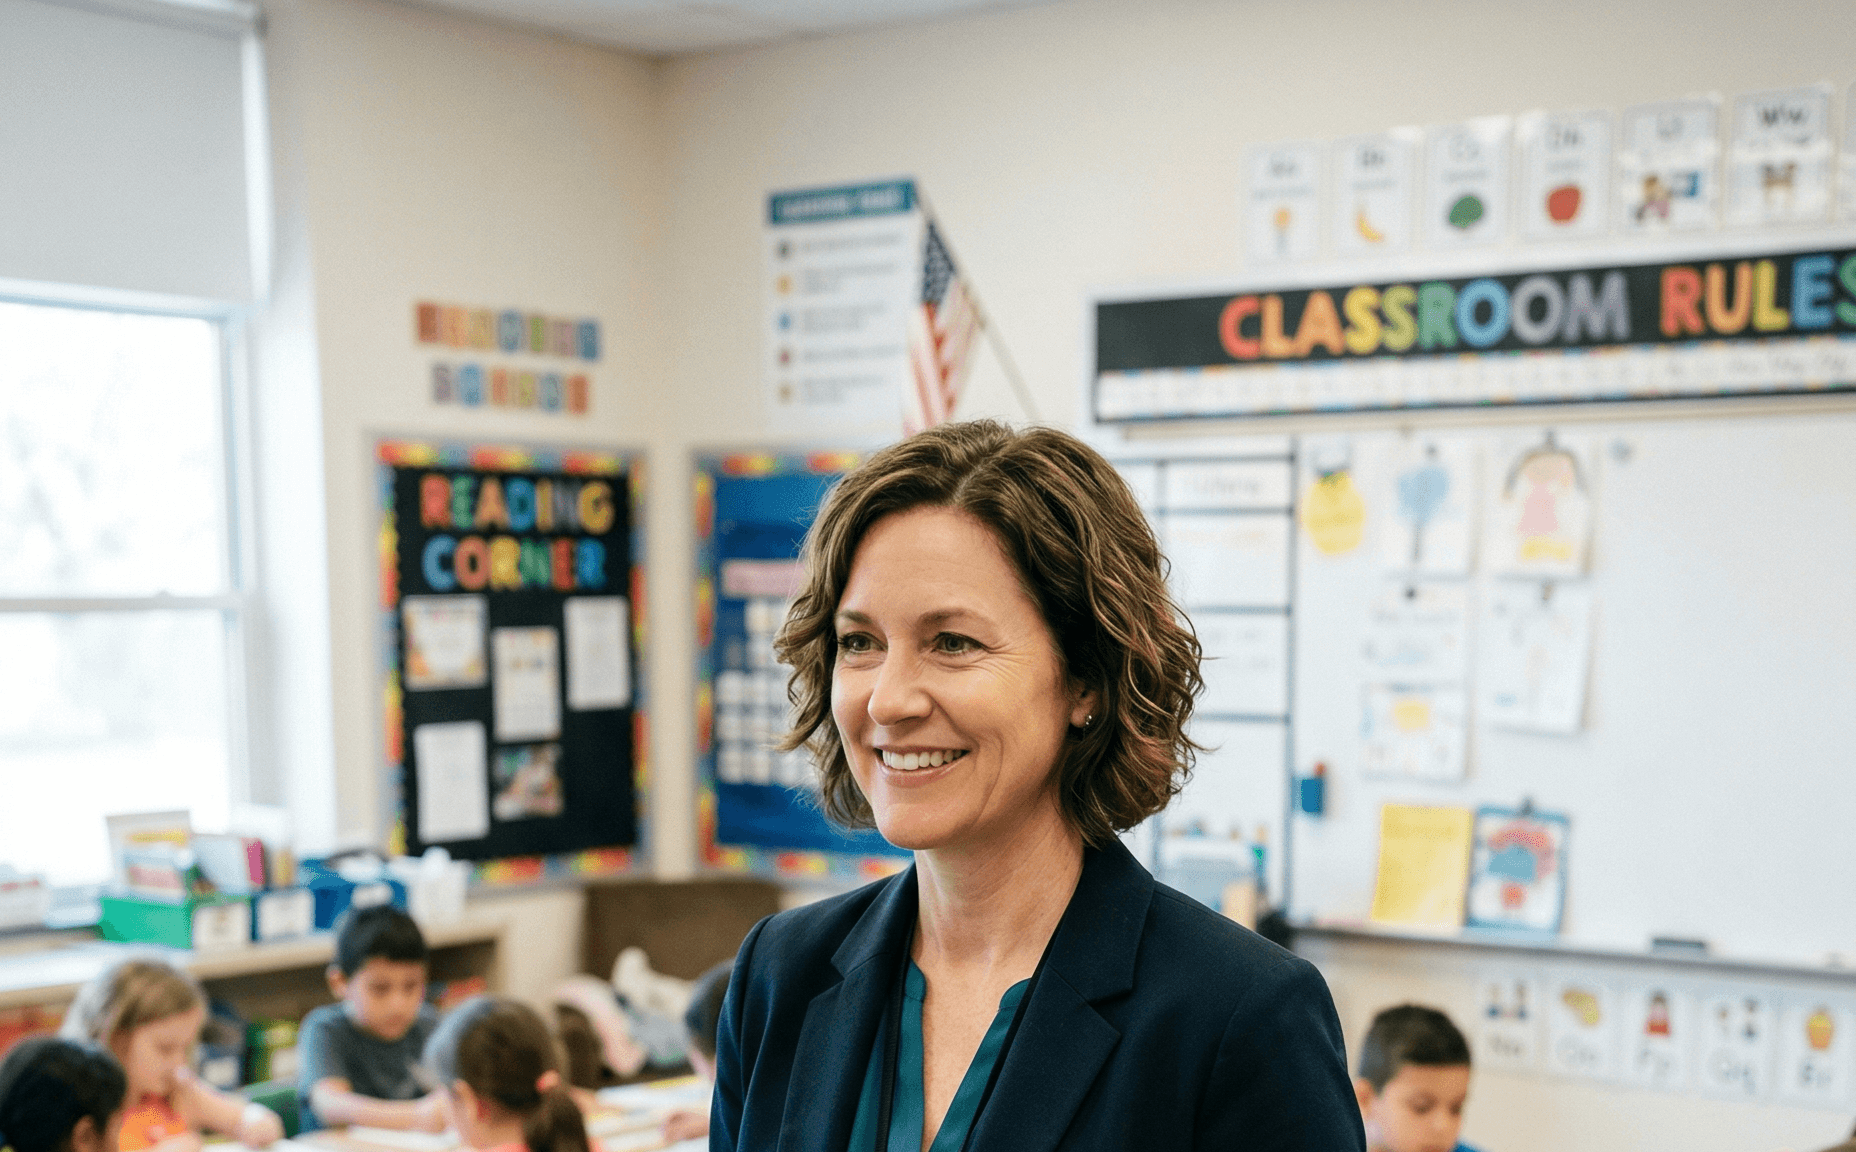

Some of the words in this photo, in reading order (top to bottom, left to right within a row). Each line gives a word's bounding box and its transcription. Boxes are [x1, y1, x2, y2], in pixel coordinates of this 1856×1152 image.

[1219, 270, 1632, 359] CLASSROOM
[419, 473, 616, 535] READING
[420, 533, 608, 590] CORNER
